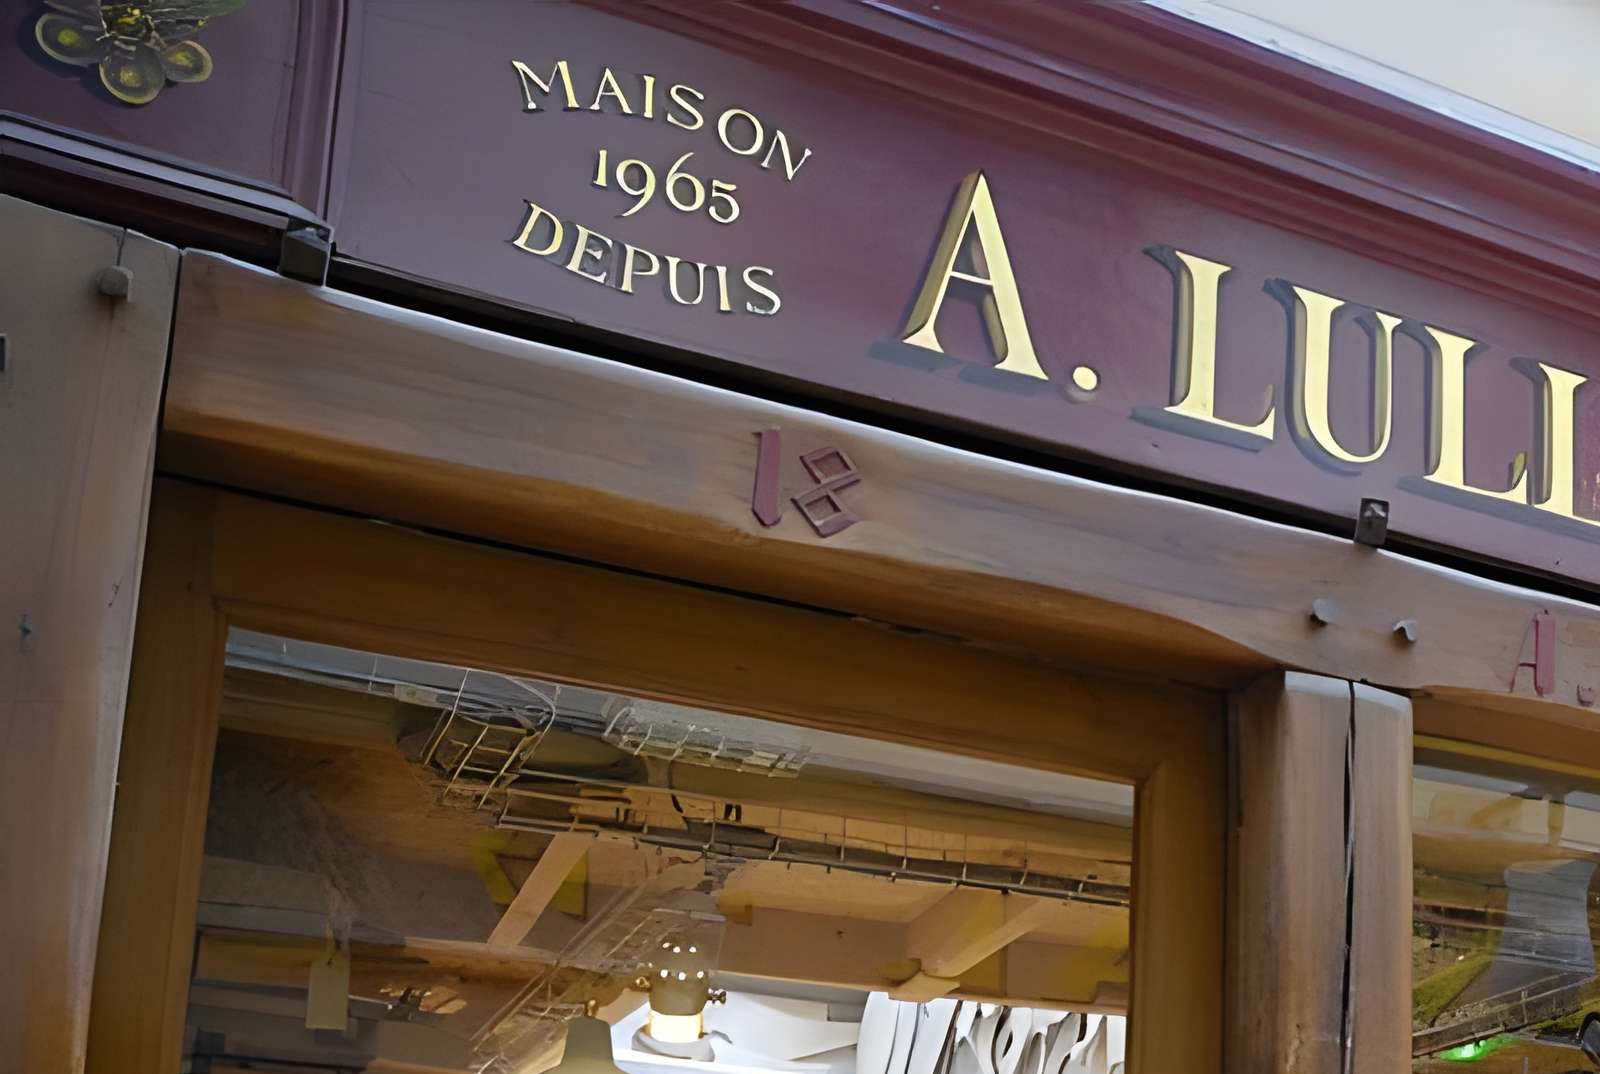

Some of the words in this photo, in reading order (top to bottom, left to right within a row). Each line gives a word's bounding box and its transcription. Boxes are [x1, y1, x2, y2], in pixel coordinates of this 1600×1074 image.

[512, 60, 812, 180] MAISON
[593, 149, 741, 224] 1965
[511, 200, 782, 316] DEPUIS
[902, 170, 1099, 391] A.
